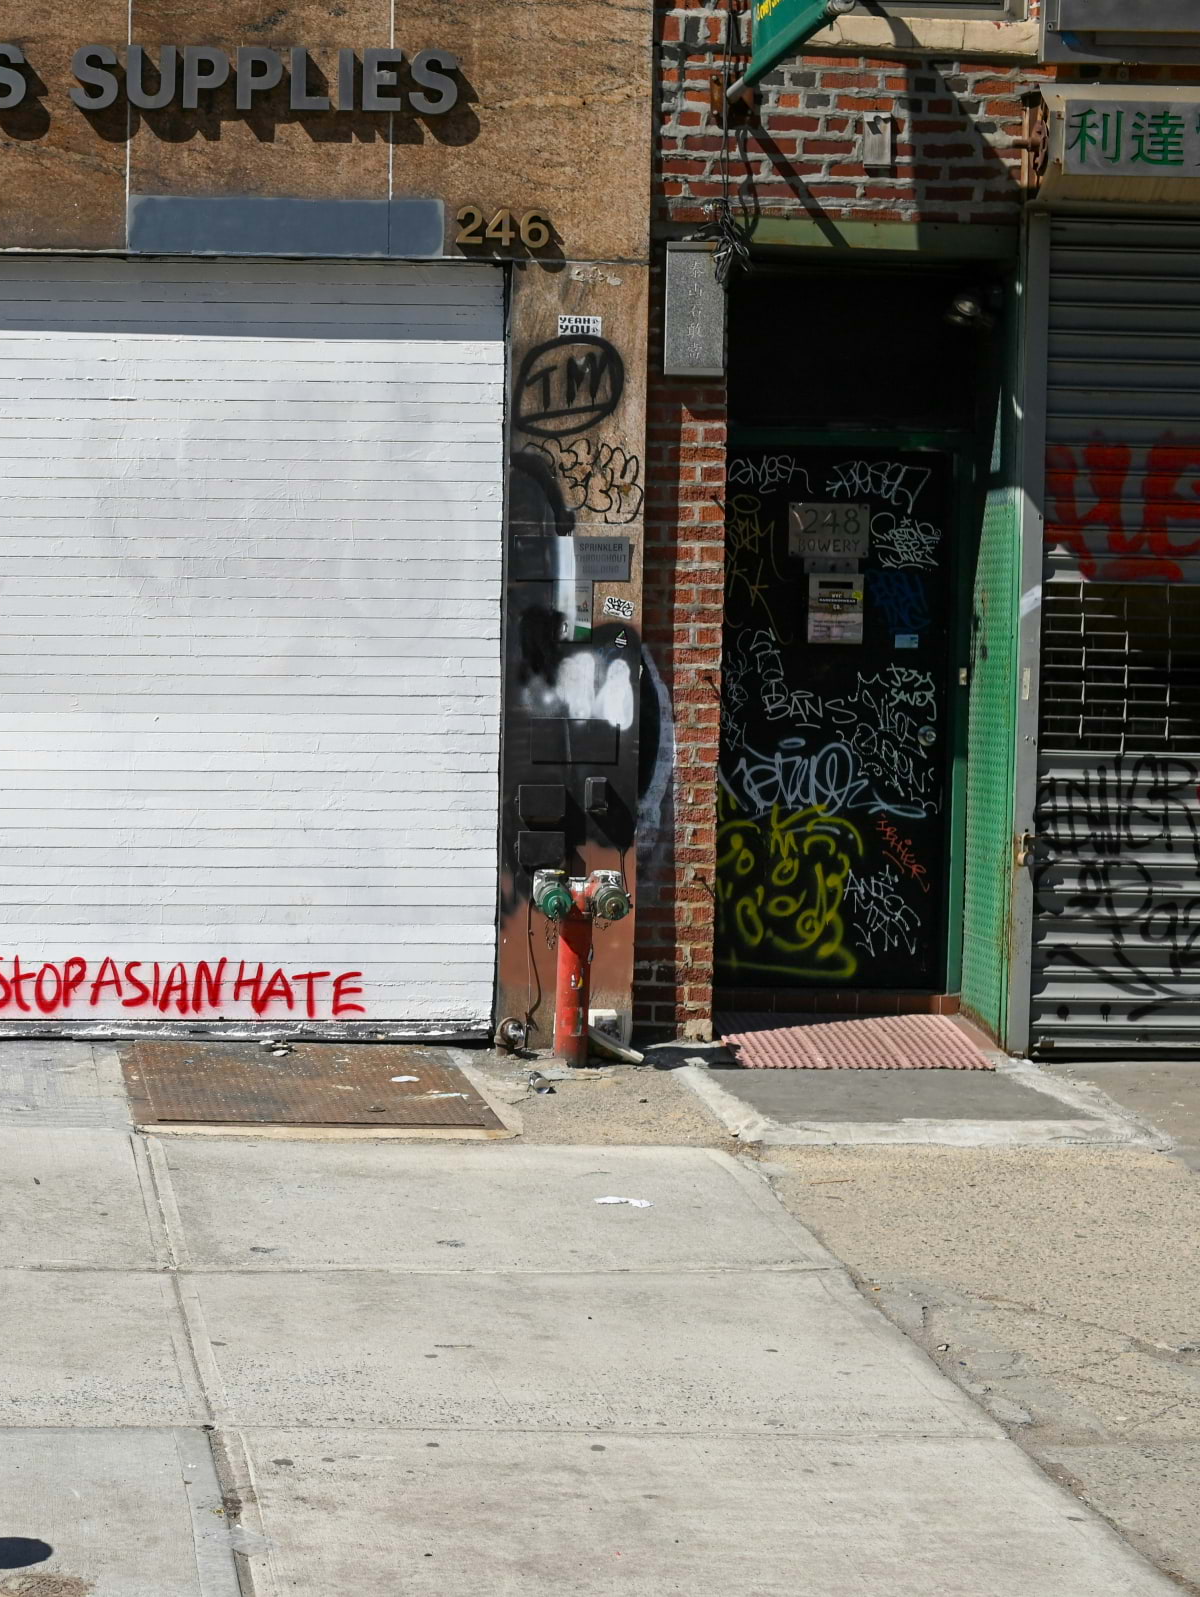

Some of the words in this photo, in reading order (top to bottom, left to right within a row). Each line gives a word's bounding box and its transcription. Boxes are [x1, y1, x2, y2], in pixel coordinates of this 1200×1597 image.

[69, 45, 459, 115] SUPPLIES
[1068, 107, 1200, 167] 利達
[455, 205, 551, 250] 246
[559, 325, 591, 334] YOU
[801, 509, 861, 535] 248
[579, 543, 623, 552] SPRINKLER
[798, 539, 861, 553] BOWERY
[576, 554, 626, 563] THROUGHOUT
